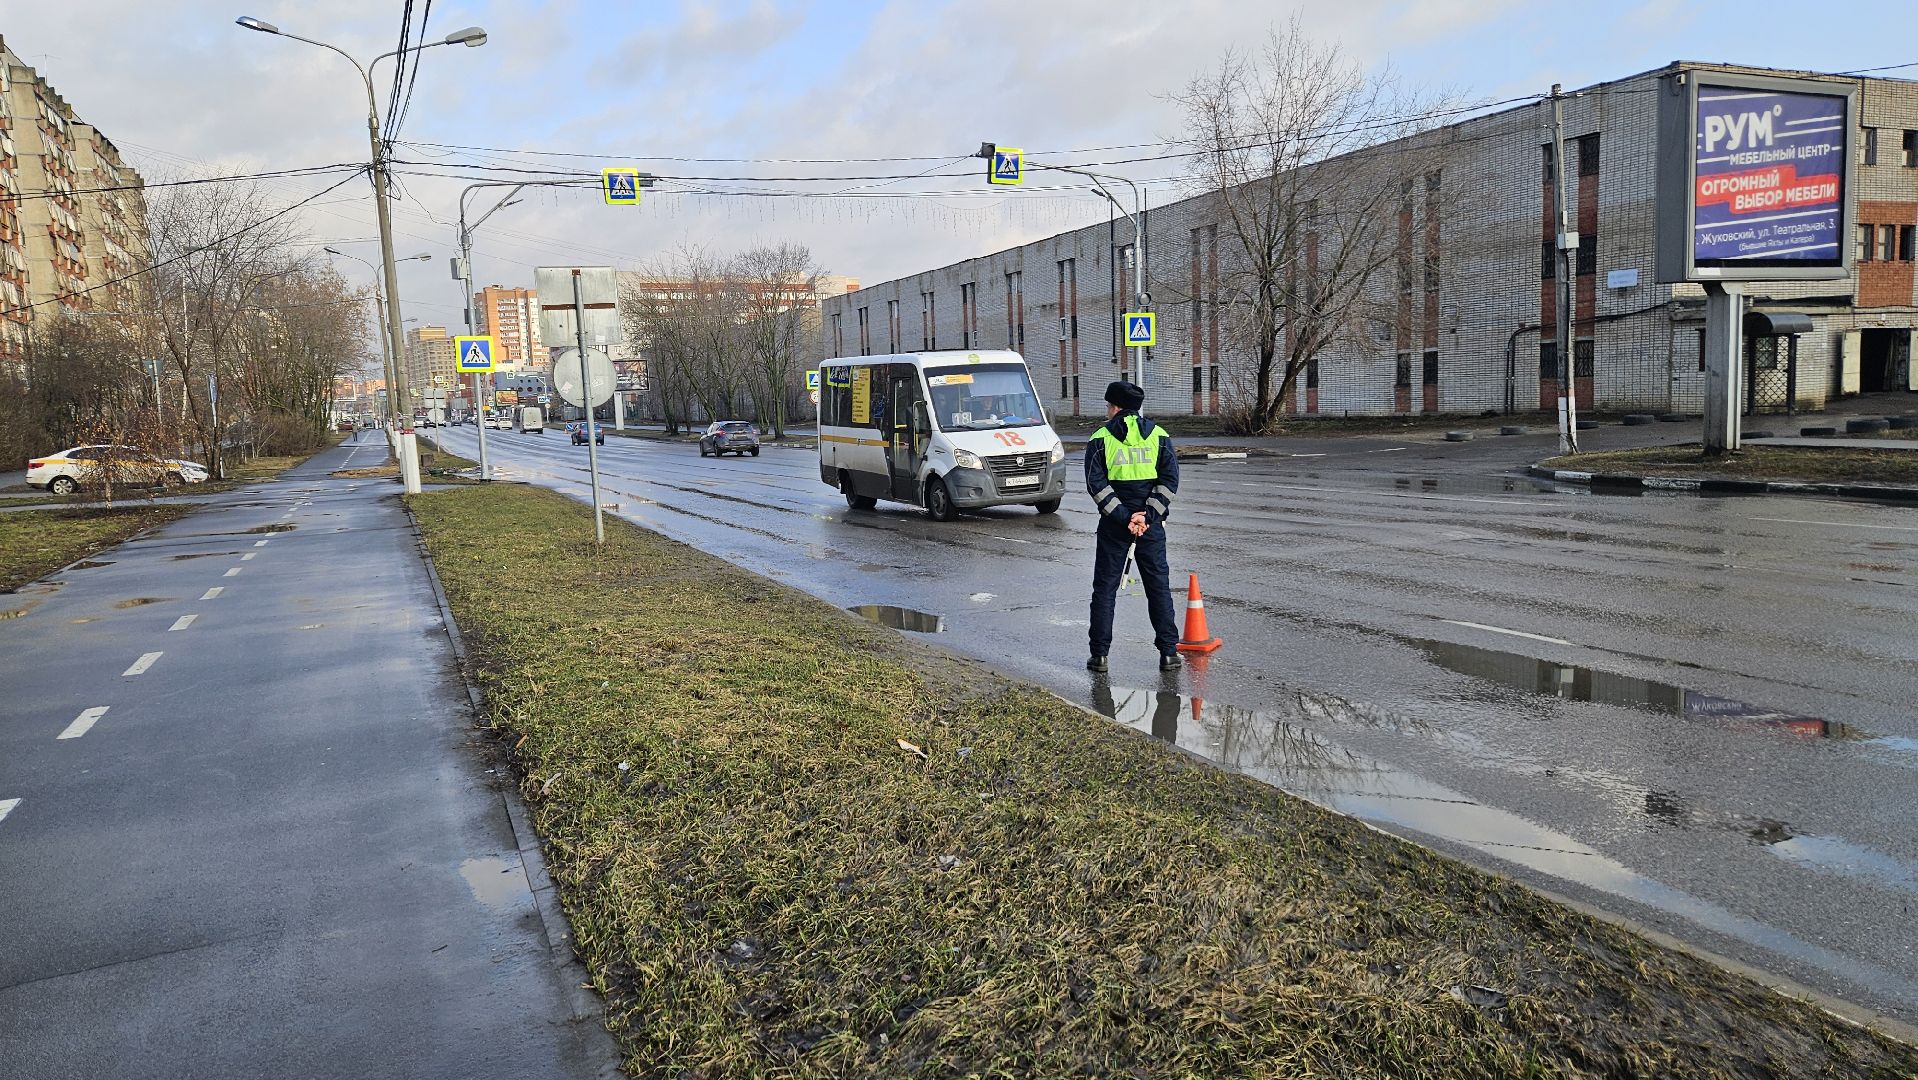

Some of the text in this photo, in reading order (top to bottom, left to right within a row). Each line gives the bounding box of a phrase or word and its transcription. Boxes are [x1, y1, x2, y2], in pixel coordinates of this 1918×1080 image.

[1730, 144, 1830, 165] МЕБЕЛЬНЫЙ ЦЕНТР
[1701, 169, 1780, 195] ОГРОМНЫЙ
[1735, 183, 1836, 210] ВЫБОР МЕБЕЛИ
[1701, 229, 1756, 245] Жуковский,
[1758, 228, 1770, 239] ул.
[1773, 220, 1827, 235] Театральная,
[954, 413, 969, 426] 18
[994, 431, 1025, 446] 18
[1115, 447, 1152, 465] ДПС
